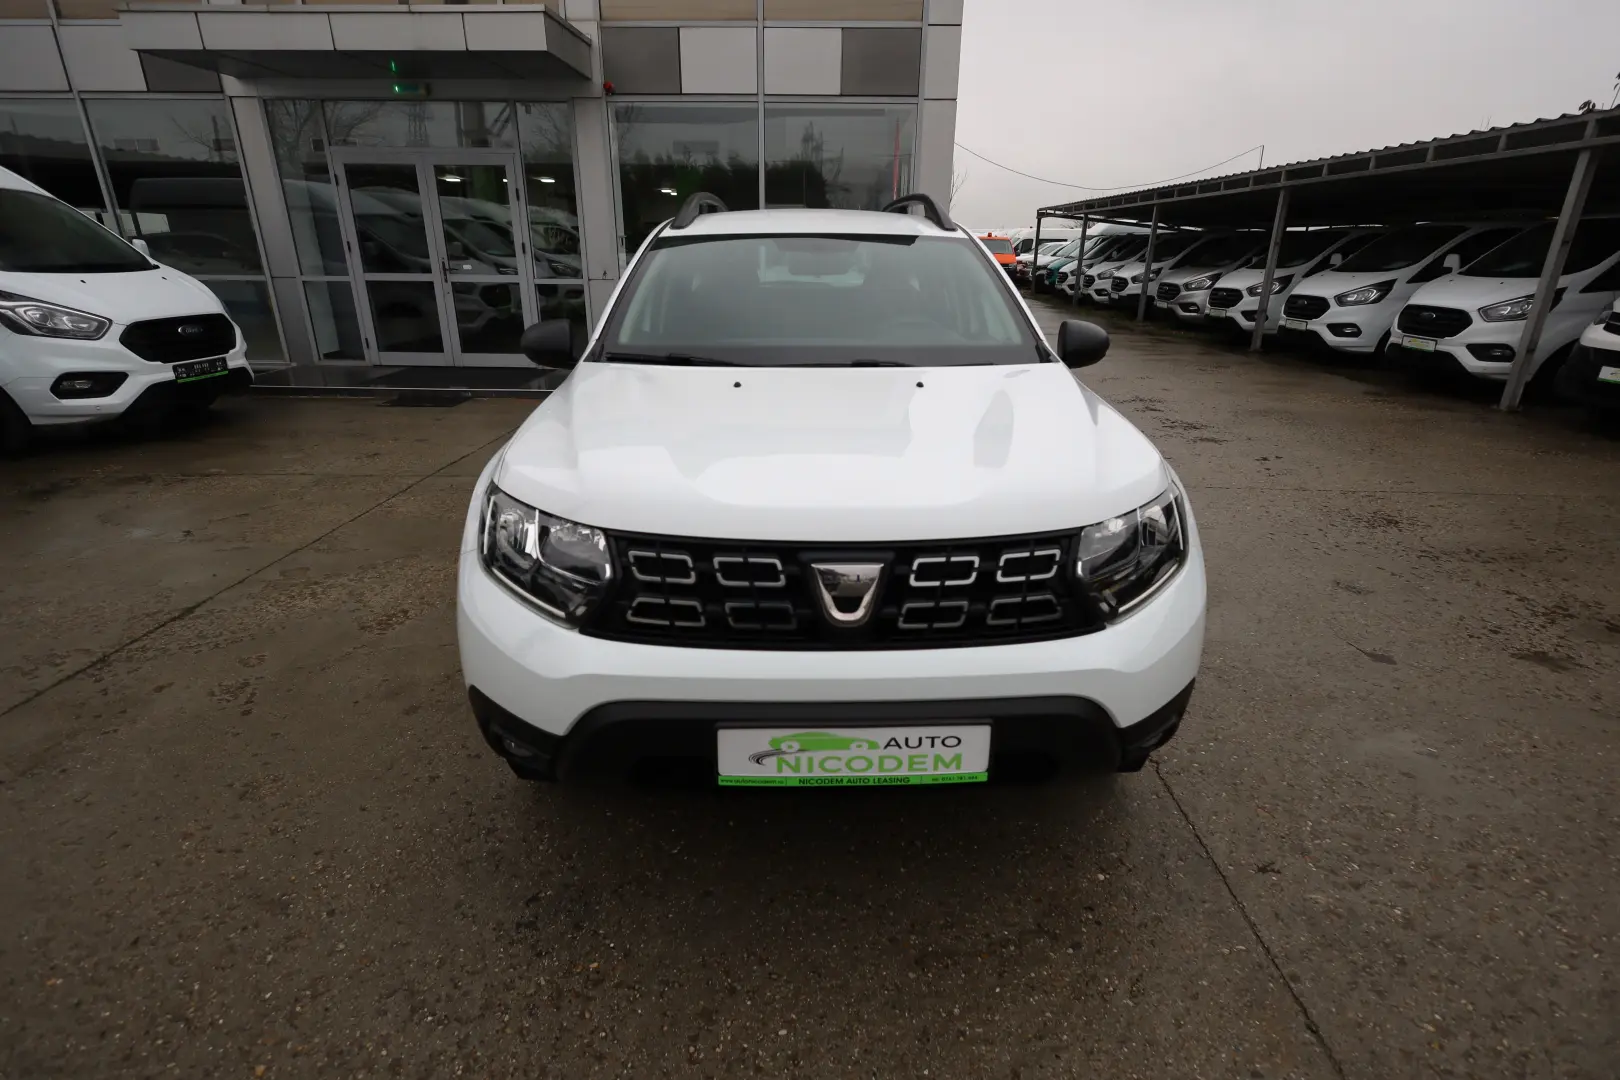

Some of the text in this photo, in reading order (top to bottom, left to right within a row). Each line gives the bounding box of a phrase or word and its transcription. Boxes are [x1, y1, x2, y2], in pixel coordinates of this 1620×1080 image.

[883, 735, 962, 750] AUTO
[776, 753, 962, 773] NICODEM
[846, 777, 870, 785] AUTO
[873, 776, 911, 784] LEASING
